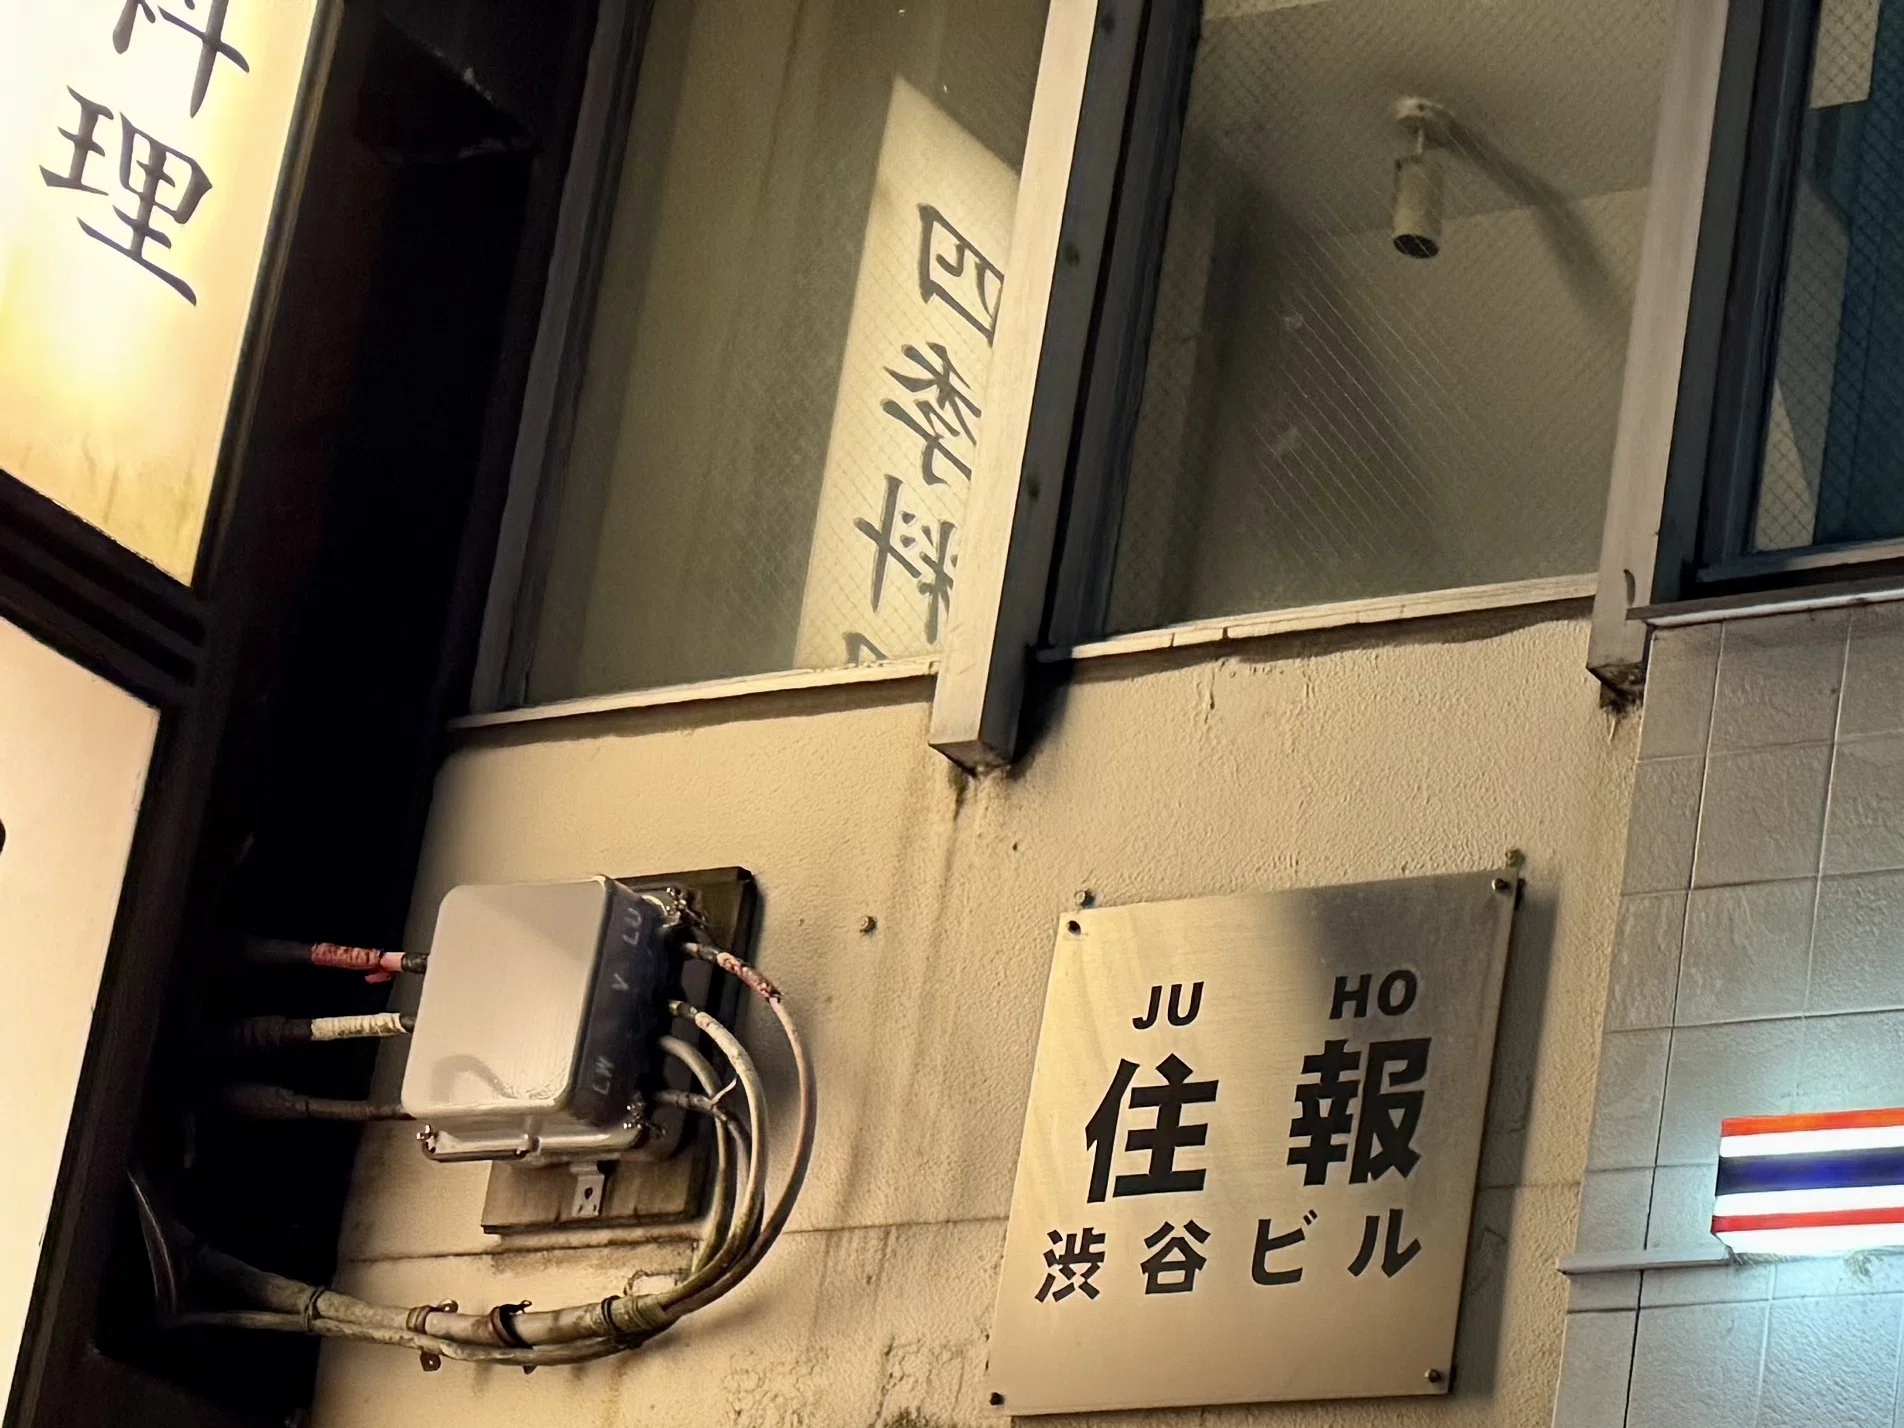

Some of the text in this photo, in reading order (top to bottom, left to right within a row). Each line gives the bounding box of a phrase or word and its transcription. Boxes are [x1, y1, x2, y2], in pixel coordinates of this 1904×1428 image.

[1131, 969, 1419, 1030] JU HO
[1034, 1208, 1423, 1304] 渋谷ビル
